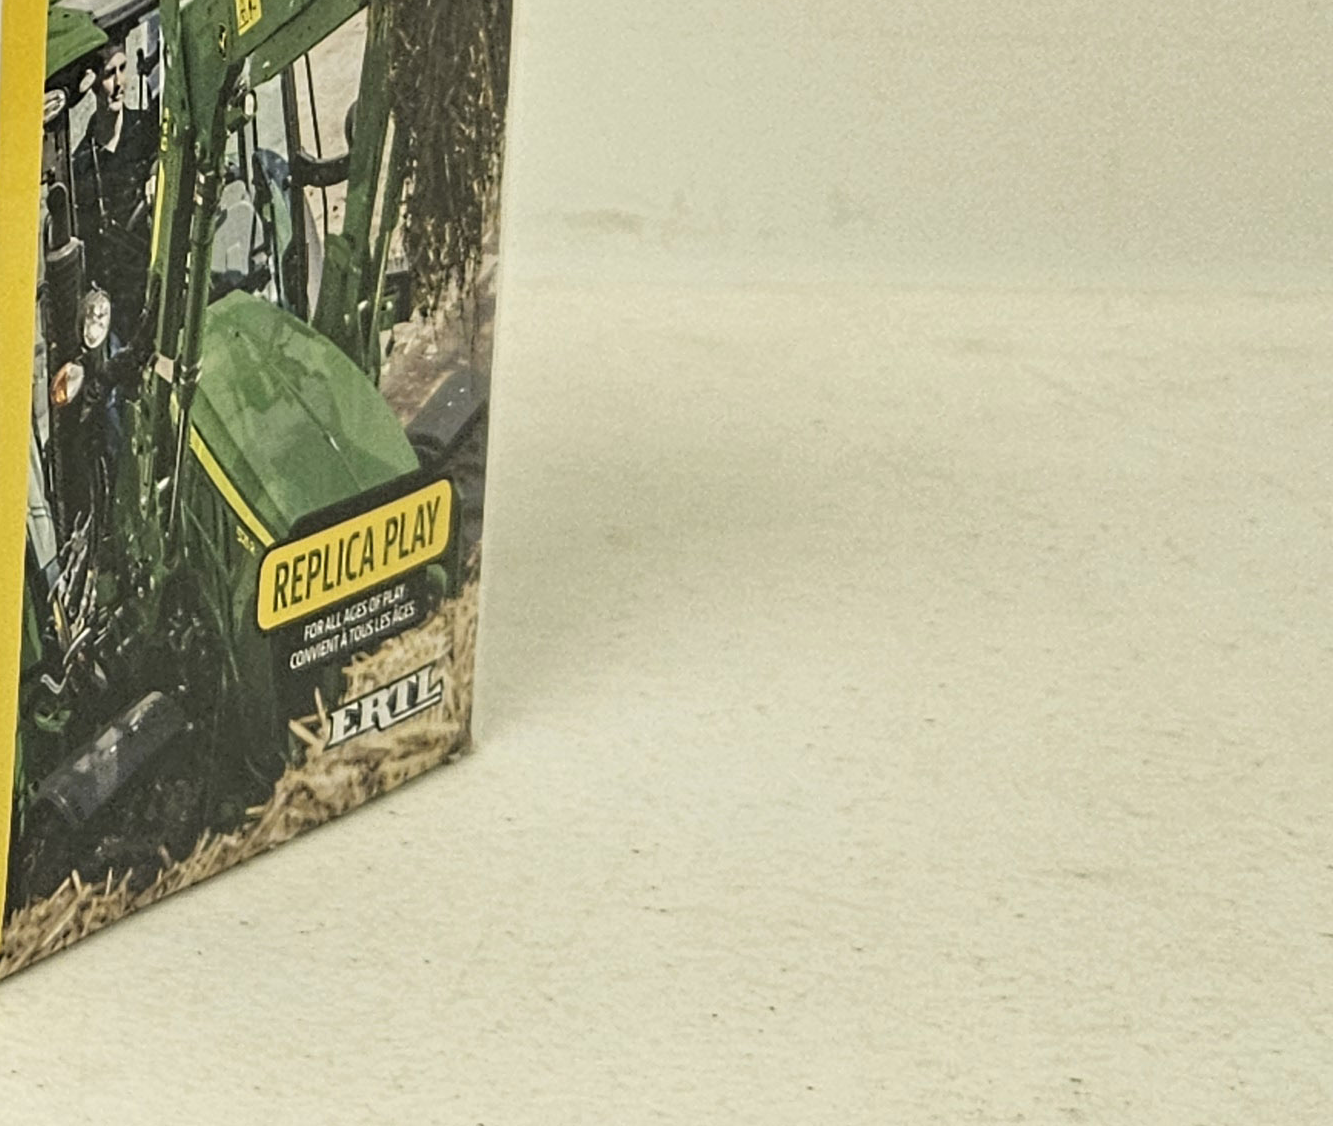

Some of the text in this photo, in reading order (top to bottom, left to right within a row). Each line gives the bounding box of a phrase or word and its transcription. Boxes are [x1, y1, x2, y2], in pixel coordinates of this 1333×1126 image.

[273, 526, 374, 612] REPLICA
[383, 496, 440, 566] PLAY
[290, 635, 339, 669] CONVIENT
[349, 619, 373, 644] TOUS
[375, 611, 392, 632] LES
[304, 584, 405, 641] FOR ALL AGES OF PLAY
[324, 661, 443, 751] ERTL
